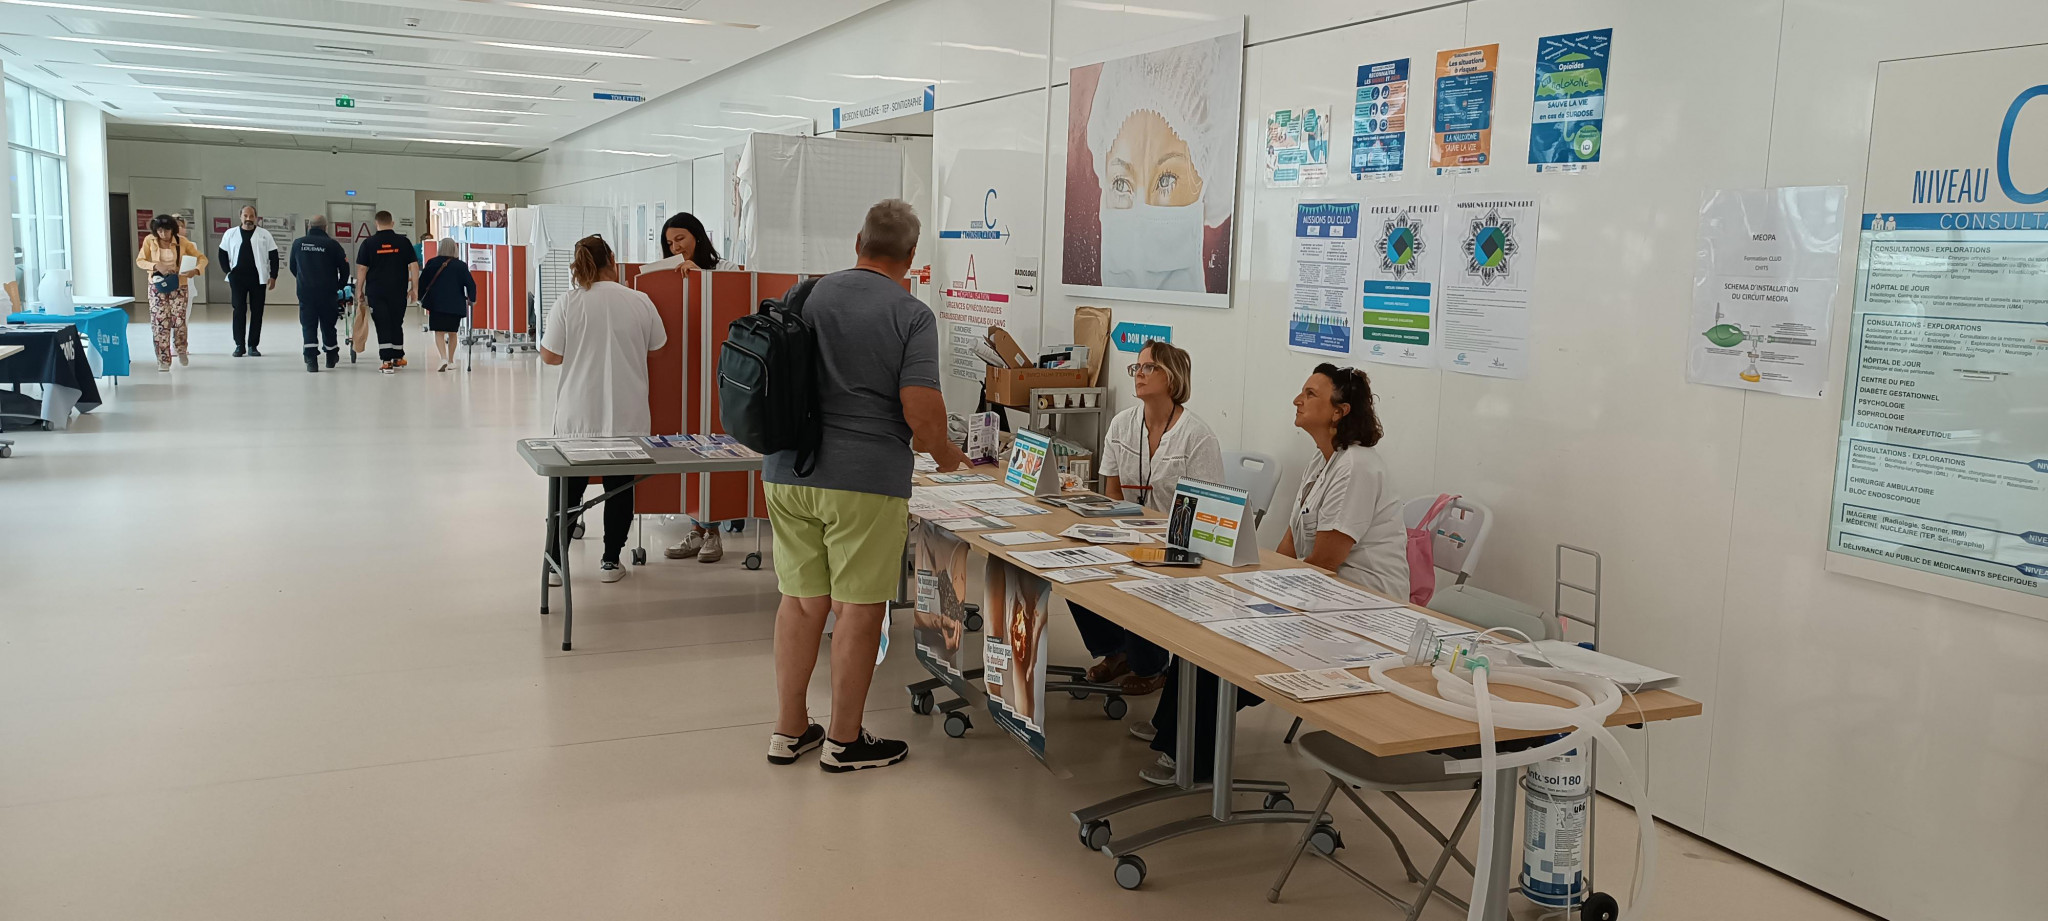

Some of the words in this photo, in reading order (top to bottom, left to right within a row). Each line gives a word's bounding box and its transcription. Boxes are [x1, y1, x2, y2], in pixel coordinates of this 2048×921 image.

[1547, 101, 1568, 109] SAUVE
[1578, 98, 1589, 106] VIE
[1565, 109, 1594, 118] SURDOSE
[1912, 167, 1990, 204] NIVEAU
[984, 188, 997, 230] C
[1302, 215, 1326, 224] MISSIONS
[1327, 215, 1336, 224] DU
[1752, 233, 1776, 241] MEOPA
[1874, 245, 1930, 253] CONSULTATIONS
[964, 253, 978, 291] A
[1014, 268, 1037, 278] RADIOLOGIE
[1724, 282, 1750, 291] SCHEMA
[1870, 283, 1898, 291] HÔPITAL
[1741, 293, 1765, 301] CIRCUIT
[1765, 295, 1789, 303] MEOPA
[945, 300, 966, 310] URGENCES
[1866, 319, 1922, 328] CONSULTATIONS
[1927, 322, 1982, 331] EXPLORATIONS
[1127, 332, 1140, 345] DON
[1863, 356, 1890, 365] HÔPITAL
[1902, 360, 1922, 368] JOUR
[1861, 376, 1887, 385] CENTRE
[1888, 378, 1898, 386] DU
[1899, 379, 1915, 387] PIED
[1888, 390, 1940, 402] GESTATIONNEL
[1858, 398, 1905, 409] PSYCHOLOGIE
[1857, 409, 1905, 421] SOPHROLOGIE
[1894, 426, 1952, 439] THÉRAPEUTIQUE
[1853, 444, 1907, 458] CONSULTATIONS
[1912, 453, 1966, 467] EXPLORATIONS
[1849, 476, 1885, 488] CHIRURGIE
[1885, 482, 1935, 496] AMBULATOIRE
[1848, 487, 1867, 496] BLOC
[1867, 490, 1921, 505] ENDOSCOPIQUE
[1846, 509, 1878, 521] IMAGERIE
[1951, 529, 1967, 538] IRM)
[1845, 517, 1878, 530] MÉDECINE
[1879, 525, 1919, 537] NUCLÉAIRE
[1937, 535, 1985, 550] Scintigraphie)
[1843, 542, 1884, 556] DÉLIVRANCE
[1884, 551, 1895, 559] AU
[1895, 553, 1920, 564] PUBLIC
[1921, 558, 1932, 566] DE
[1933, 559, 1985, 577] MÉDICAMENTS
[1987, 571, 2038, 588] SPÉCIFIQUES
[1561, 775, 1582, 787] 180
